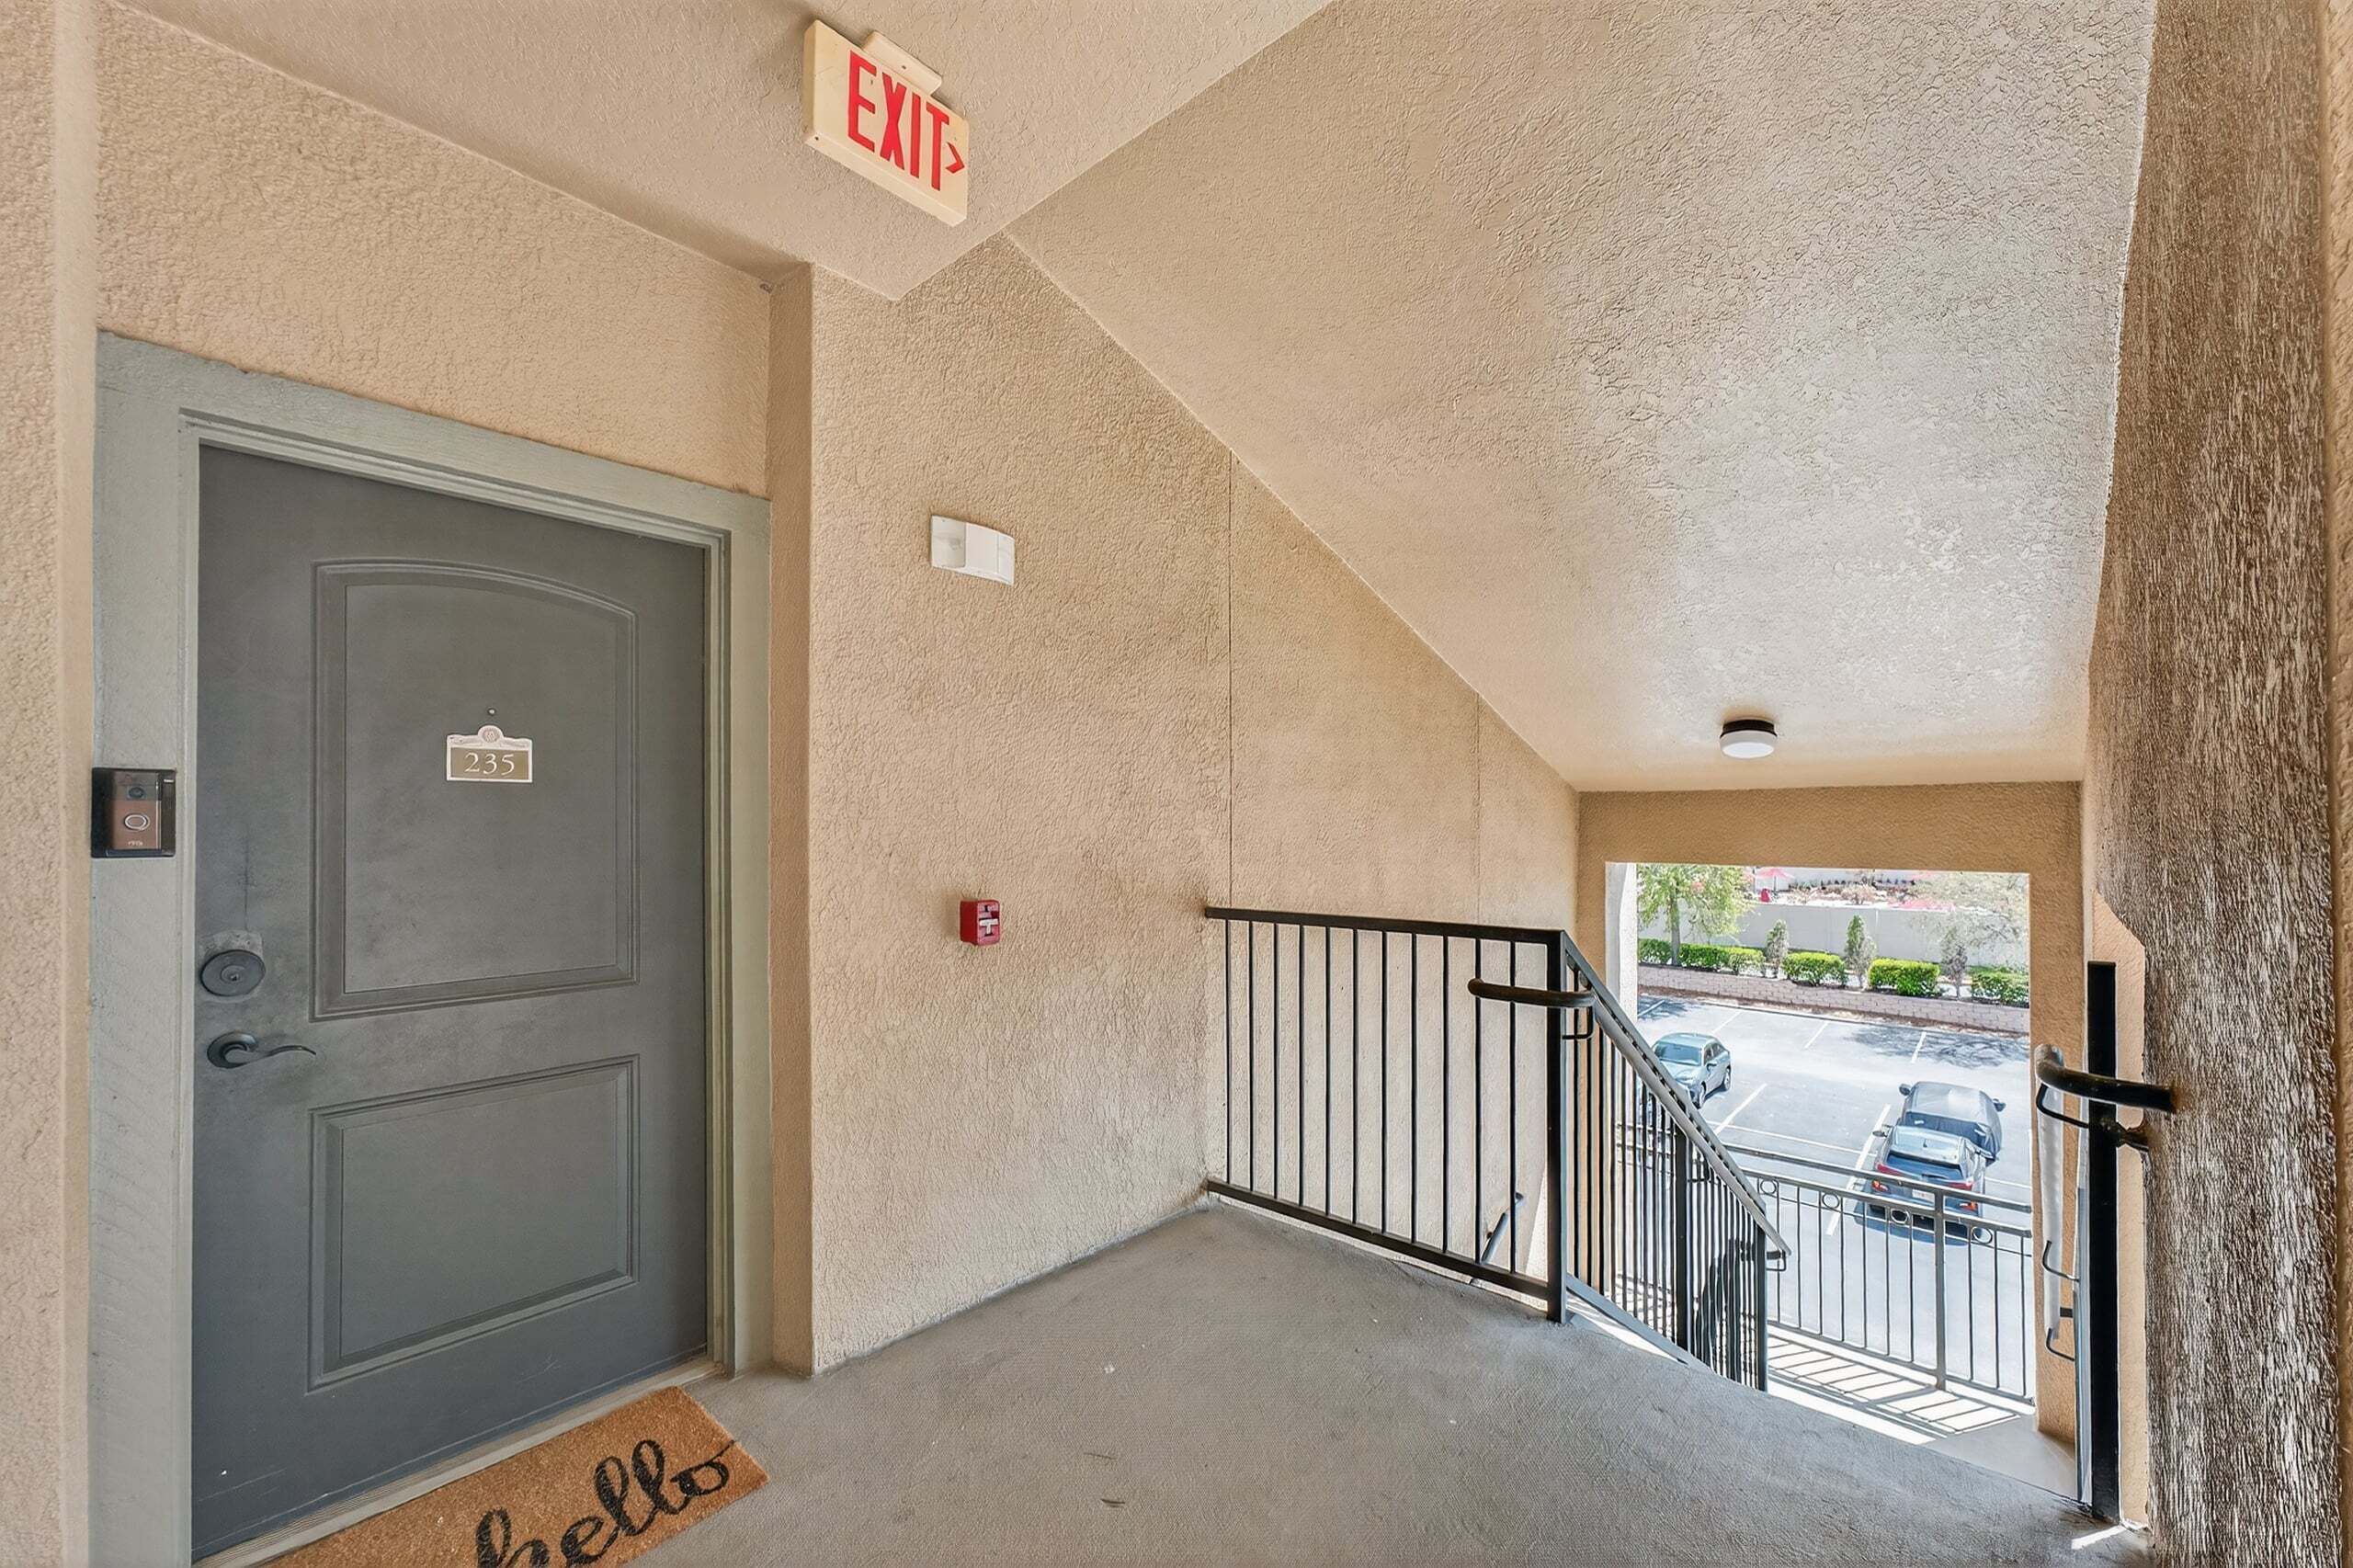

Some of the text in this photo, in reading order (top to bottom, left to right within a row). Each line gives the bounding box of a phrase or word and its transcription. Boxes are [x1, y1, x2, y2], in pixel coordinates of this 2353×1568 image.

[847, 50, 949, 191] EXIT
[464, 752, 515, 776] 235
[475, 1439, 735, 1568] hello
